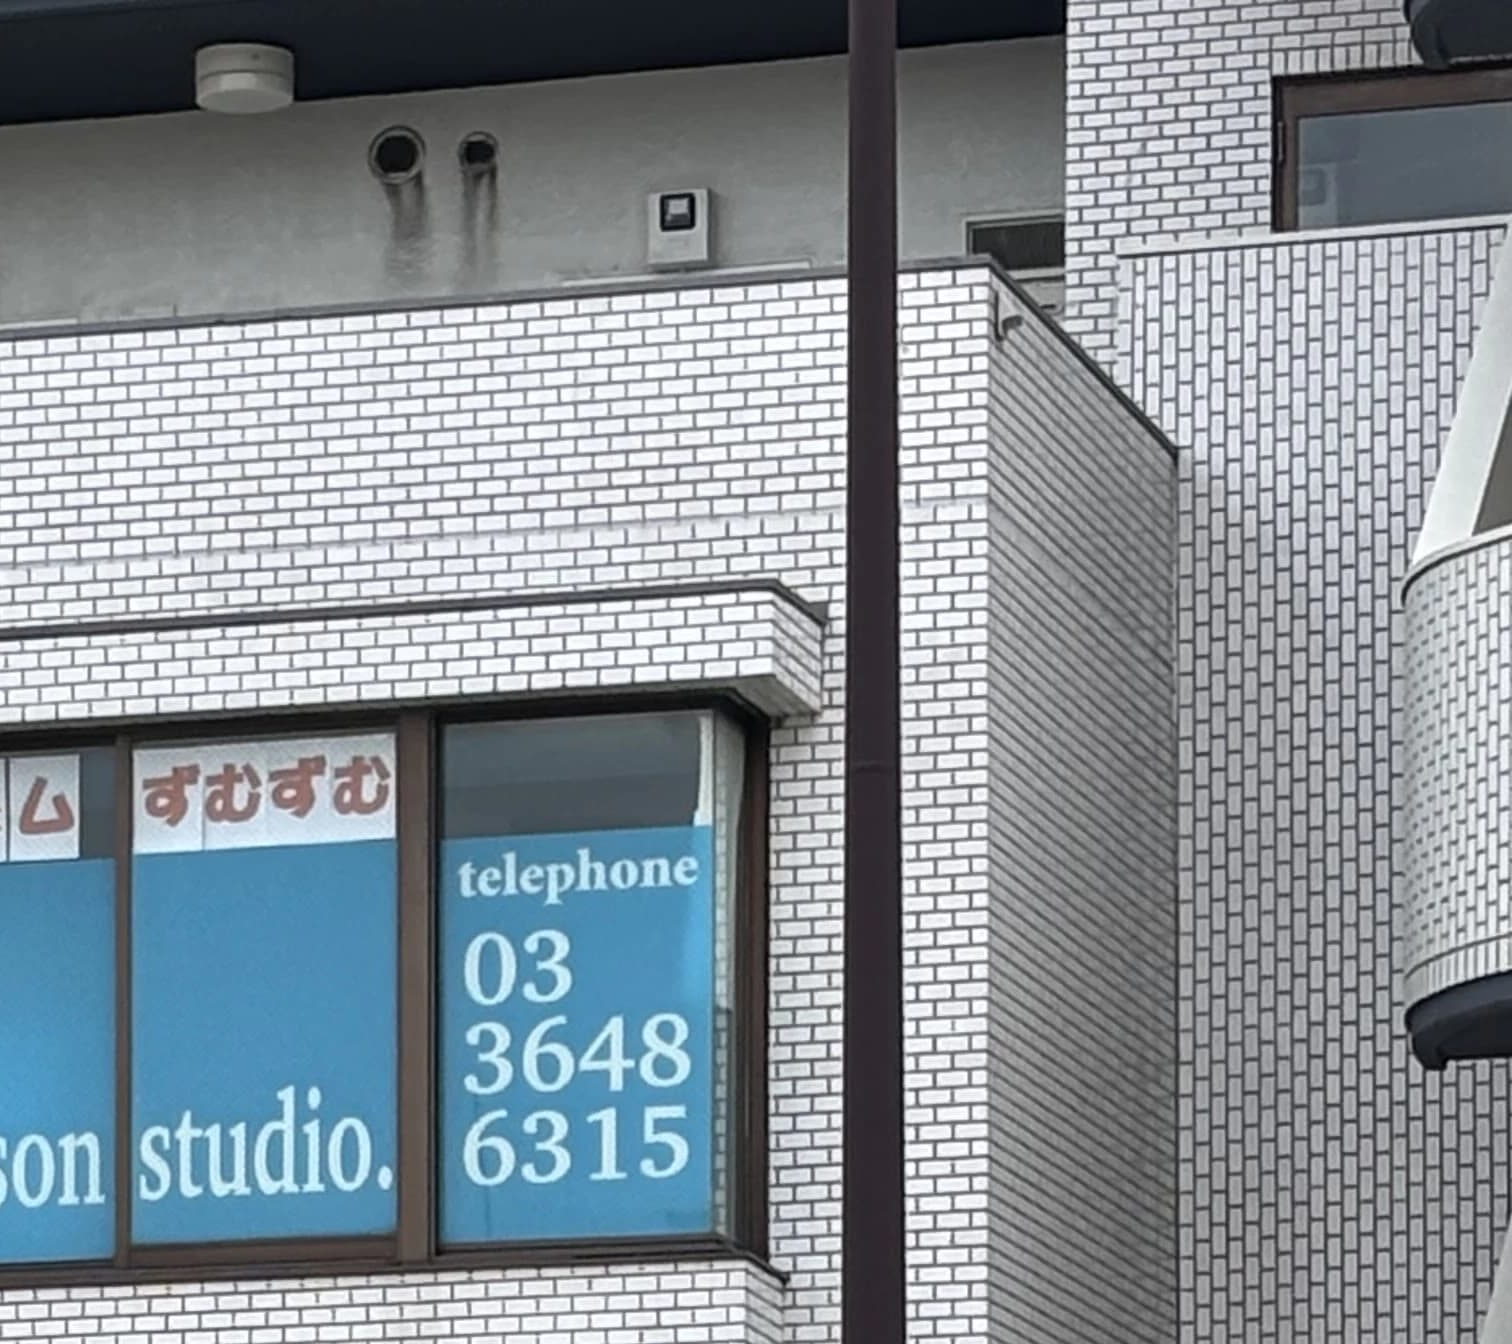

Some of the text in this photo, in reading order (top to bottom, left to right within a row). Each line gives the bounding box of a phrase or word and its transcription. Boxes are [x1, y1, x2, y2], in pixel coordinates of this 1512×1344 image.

[142, 755, 391, 827] ずむずむ
[458, 848, 700, 905] telephone
[463, 929, 573, 1006] 03
[463, 1012, 692, 1096] 3648
[139, 1085, 393, 1201] studio.
[462, 1105, 691, 1186] 6315
